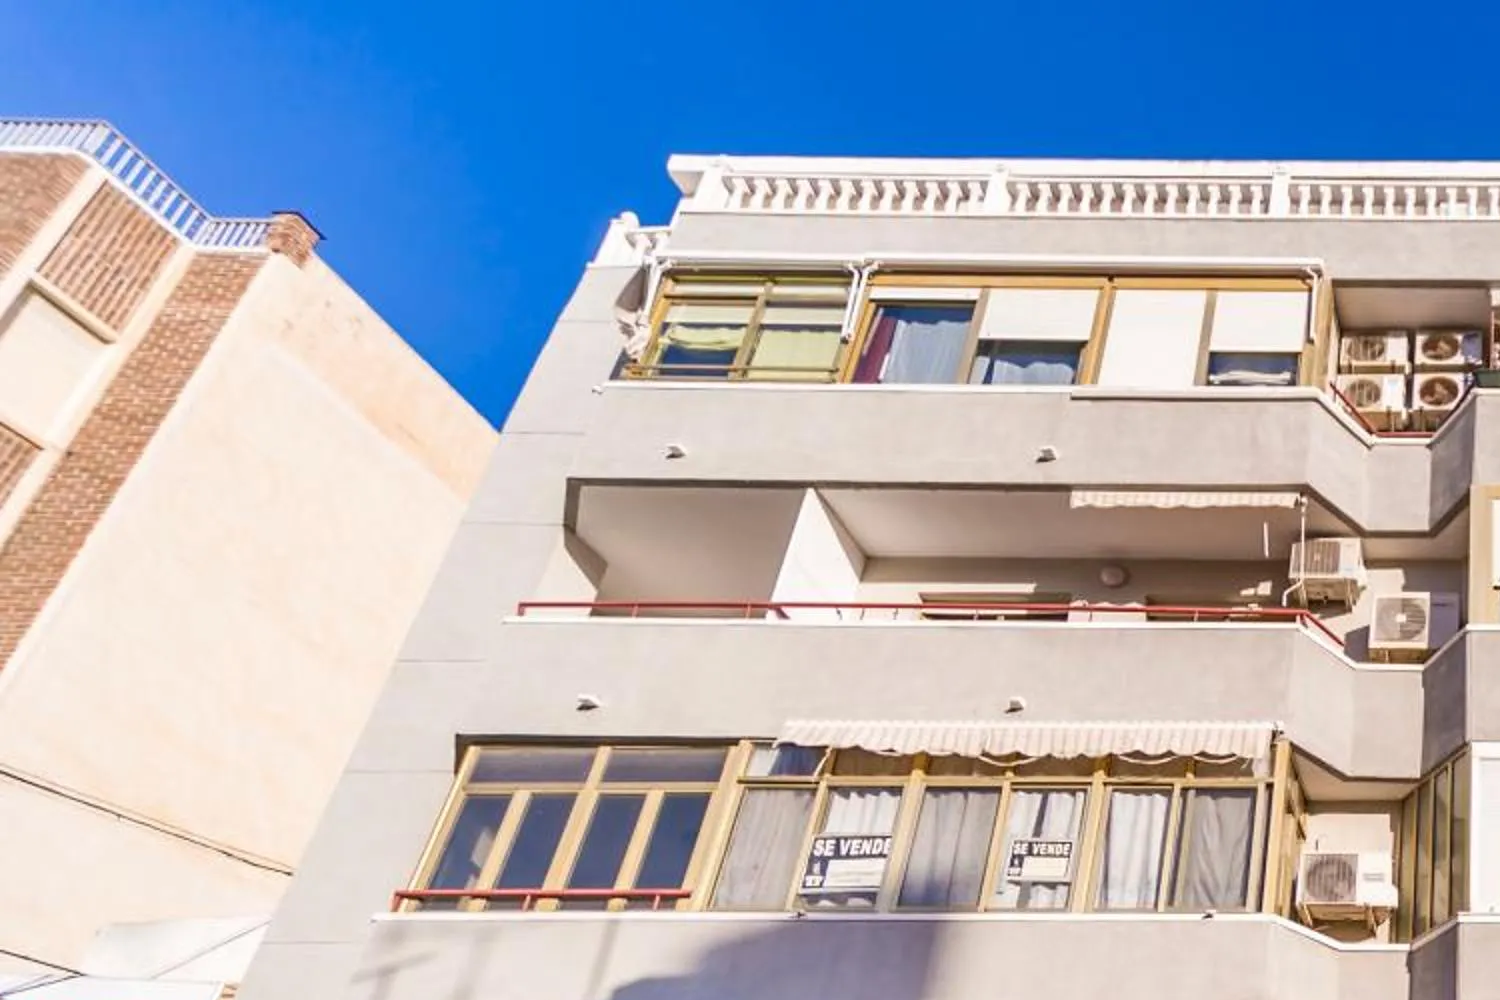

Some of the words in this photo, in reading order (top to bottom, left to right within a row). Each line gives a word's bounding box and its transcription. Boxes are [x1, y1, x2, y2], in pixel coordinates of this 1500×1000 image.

[813, 839, 837, 857] SE
[1013, 843, 1029, 855] SE
[1032, 843, 1071, 856] VENDE
